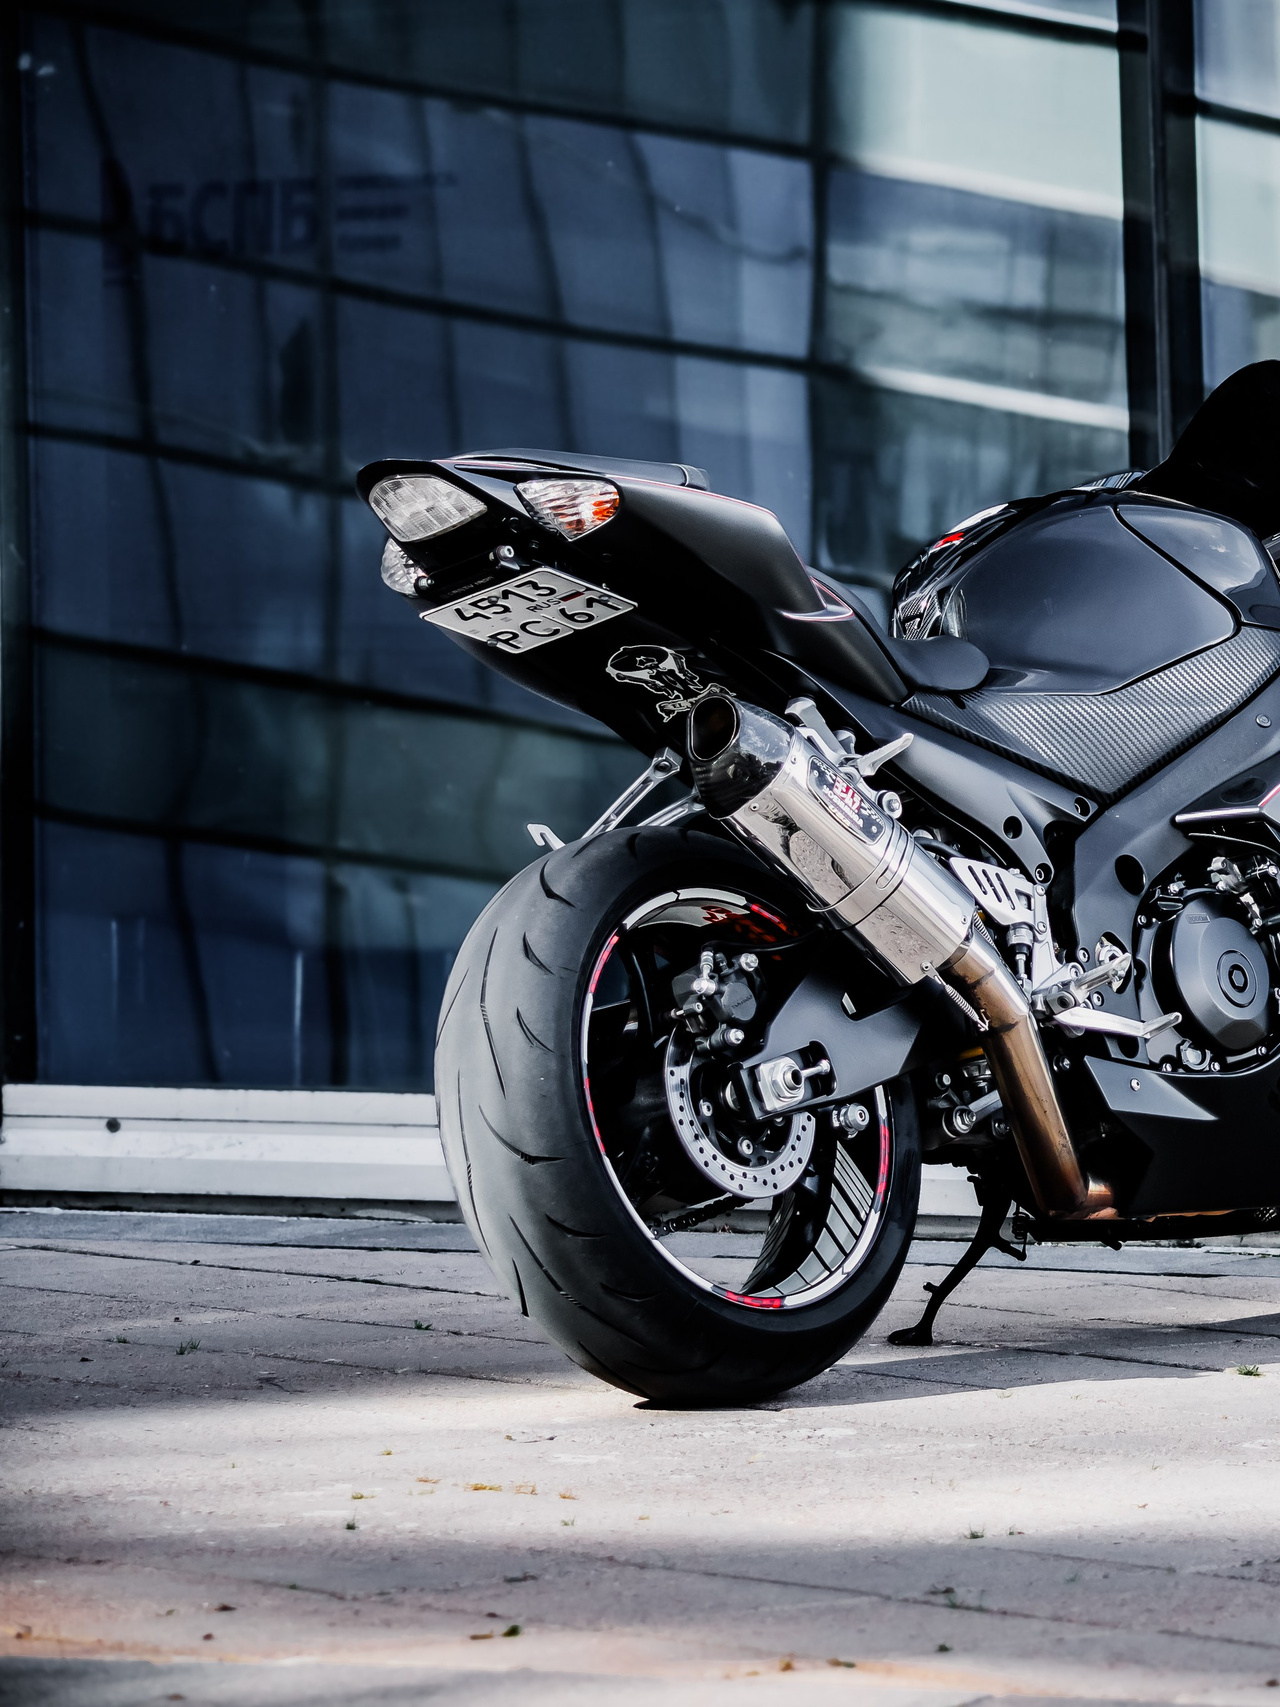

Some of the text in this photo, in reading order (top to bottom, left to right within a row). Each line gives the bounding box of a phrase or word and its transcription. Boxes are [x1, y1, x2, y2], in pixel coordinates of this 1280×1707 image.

[454, 580, 557, 621] 4513
[526, 598, 561, 612] RUS
[559, 596, 622, 624] 61
